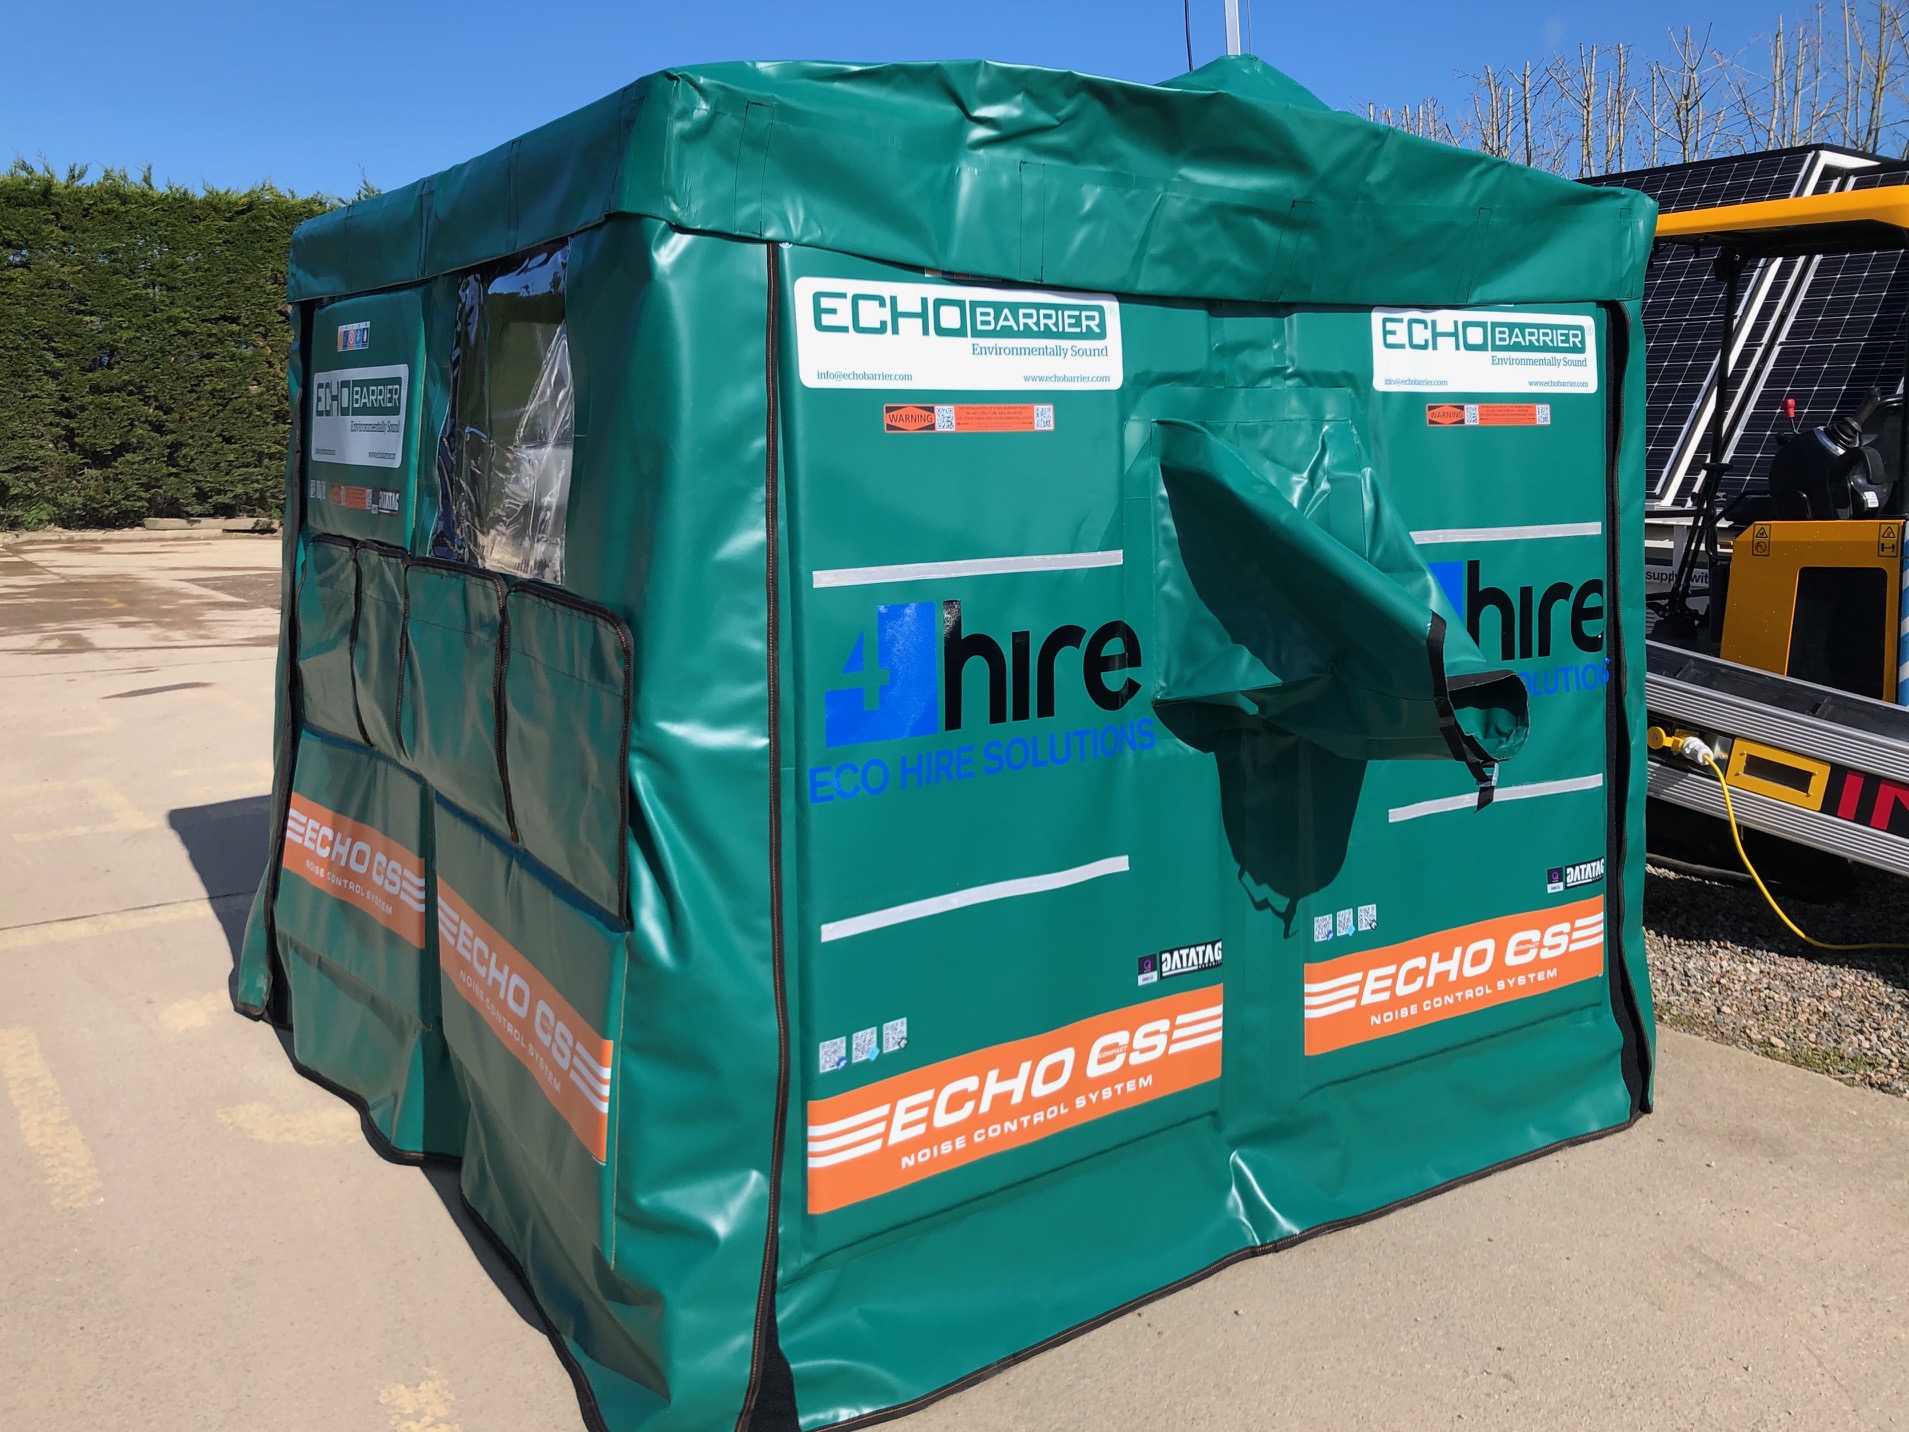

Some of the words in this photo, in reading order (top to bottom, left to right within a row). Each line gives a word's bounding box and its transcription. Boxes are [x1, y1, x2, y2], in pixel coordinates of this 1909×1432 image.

[812, 291, 968, 338] ECHO
[975, 307, 1101, 333] BARRIER
[971, 343, 1068, 359] Environmentally
[1070, 345, 1109, 357] Sound
[1382, 317, 1489, 351] ECHO
[1495, 327, 1582, 347] BARRIER
[817, 370, 913, 382] info@echobarrier.com
[1023, 373, 1110, 384] www.echobarrier.com
[1491, 355, 1561, 368] Environmentally
[1562, 356, 1587, 367] Sound
[316, 381, 351, 416] ECHO
[353, 385, 400, 408] BARRIER
[1528, 379, 1589, 388] www.echobarrier.com
[888, 414, 933, 424] WARNING
[1431, 411, 1464, 419] WARNING
[809, 759, 889, 804] ECO
[900, 745, 975, 790] HIRE
[983, 717, 1156, 775] SOLUTIONS
[304, 819, 371, 874] ECHO
[372, 851, 402, 895] CS
[1567, 858, 1604, 884] DATATAG
[306, 859, 325, 877] NOISE
[327, 872, 364, 896] CONTROL
[367, 891, 393, 914] SYSTEM
[1162, 941, 1222, 972] DATATAG
[1361, 938, 1495, 1005] ECHO
[1505, 922, 1571, 966] CS
[457, 919, 530, 1018] ECHO
[535, 1000, 573, 1071] CS
[1371, 1003, 1418, 1025] NOISE
[1423, 984, 1492, 1011] CONTROL
[1497, 968, 1557, 990] SYSTEM
[460, 970, 485, 1000] NOISE
[486, 996, 525, 1047] CONTROL
[529, 1043, 561, 1094] SYSTEM
[887, 1046, 1075, 1146] ECHO
[1086, 1019, 1171, 1078] CS
[901, 1135, 966, 1169] NOISE
[974, 1103, 1069, 1143] CONTROL
[1076, 1074, 1153, 1109] SYSTEM
